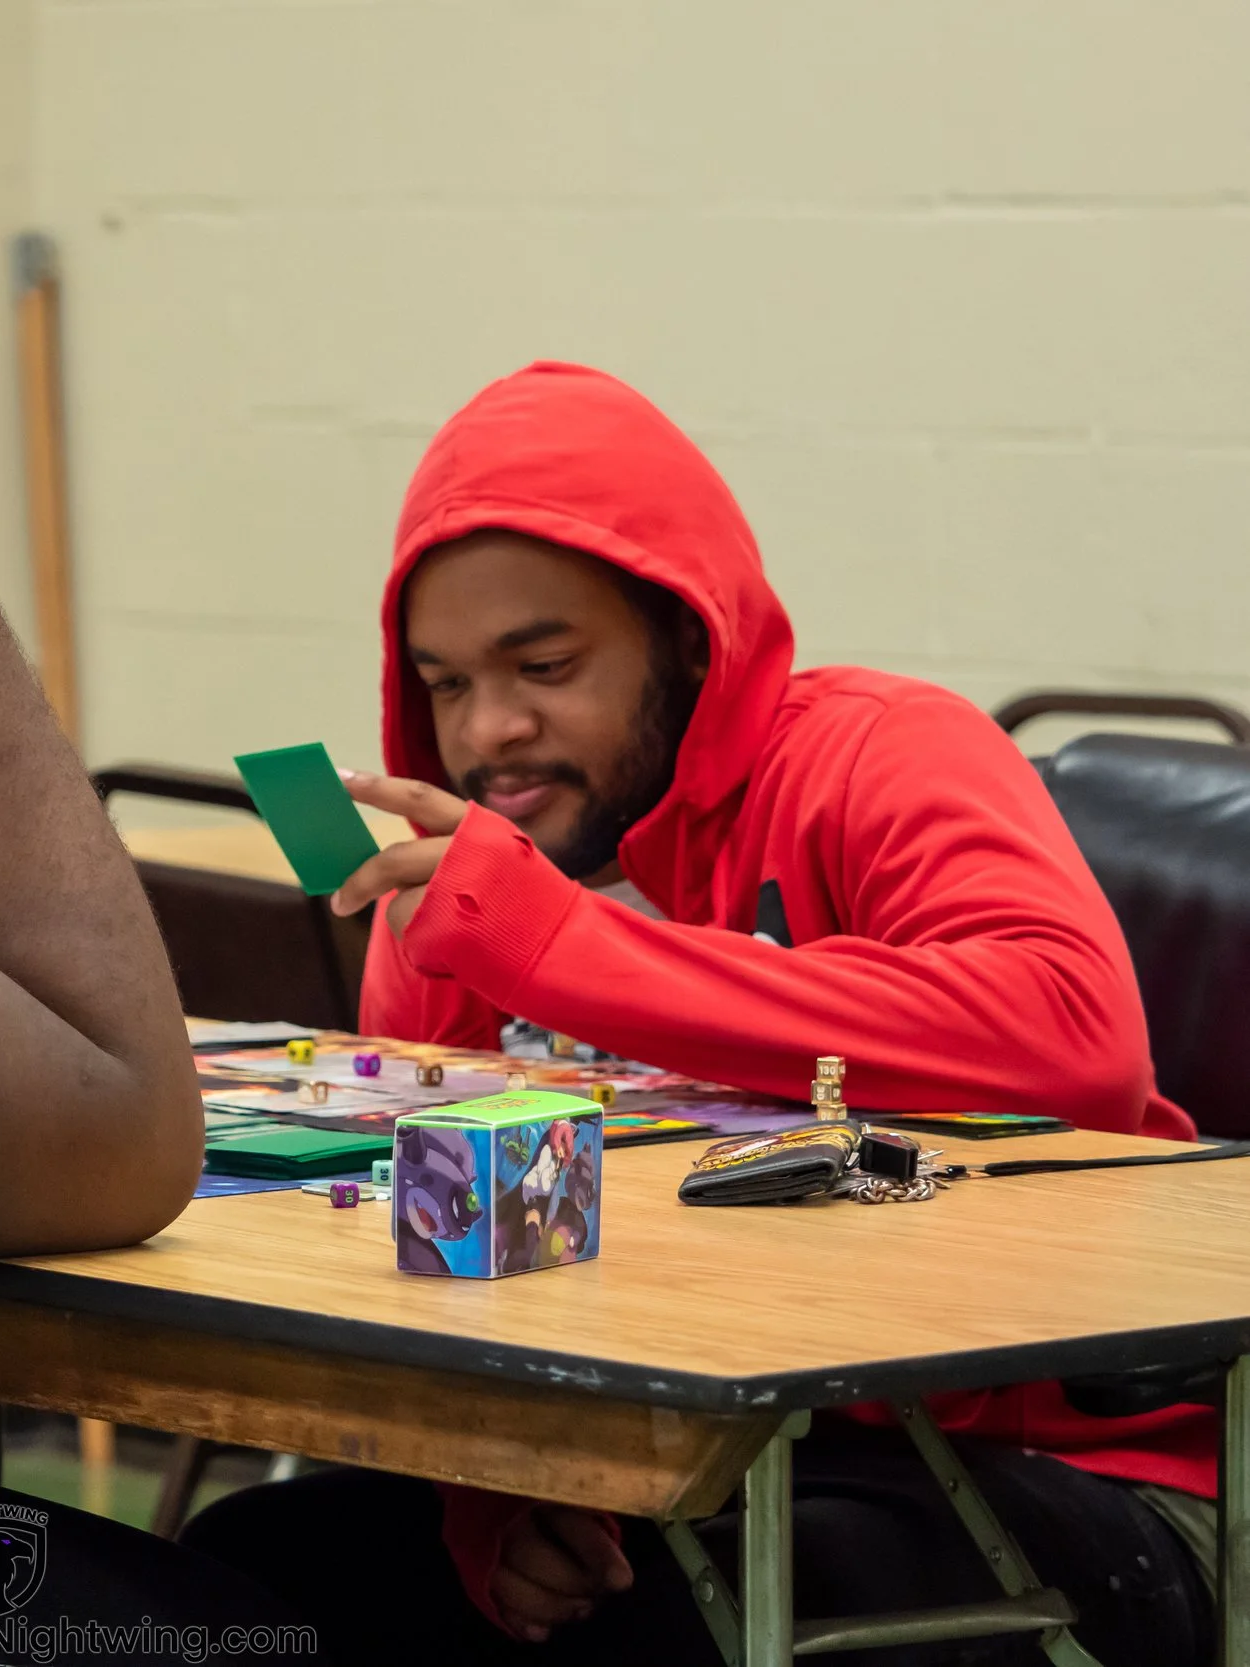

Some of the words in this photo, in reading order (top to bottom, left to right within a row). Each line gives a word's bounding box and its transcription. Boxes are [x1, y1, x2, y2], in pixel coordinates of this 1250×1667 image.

[819, 1065, 835, 1075] 130
[380, 1168, 389, 1181] 30
[345, 1190, 353, 1203] 30
